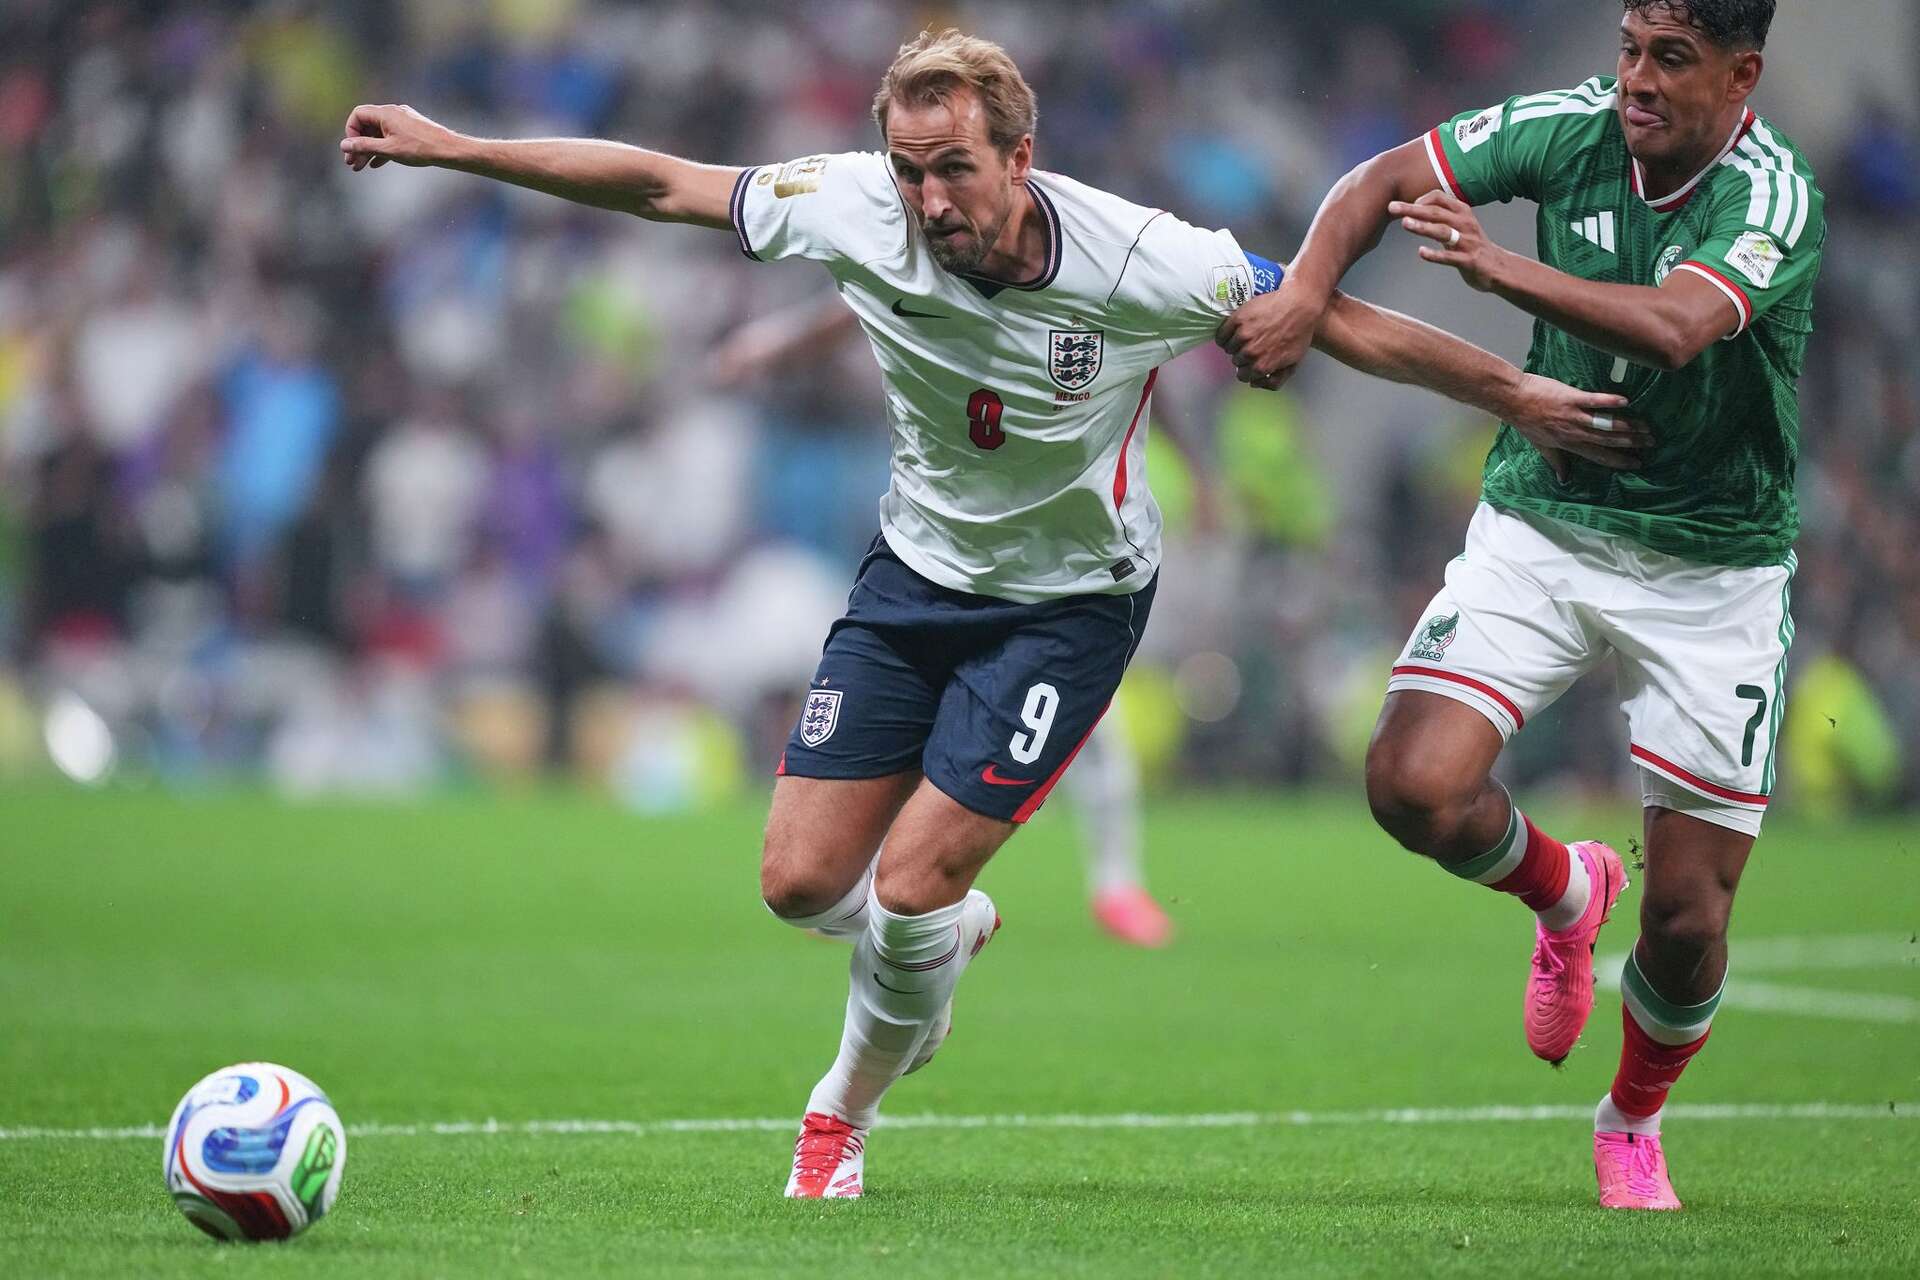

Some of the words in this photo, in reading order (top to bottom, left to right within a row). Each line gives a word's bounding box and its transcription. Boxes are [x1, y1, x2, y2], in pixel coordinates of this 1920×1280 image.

[1055, 391, 1091, 401] MEXICO
[1009, 682, 1060, 765] 9
[1735, 684, 1767, 767] 7
